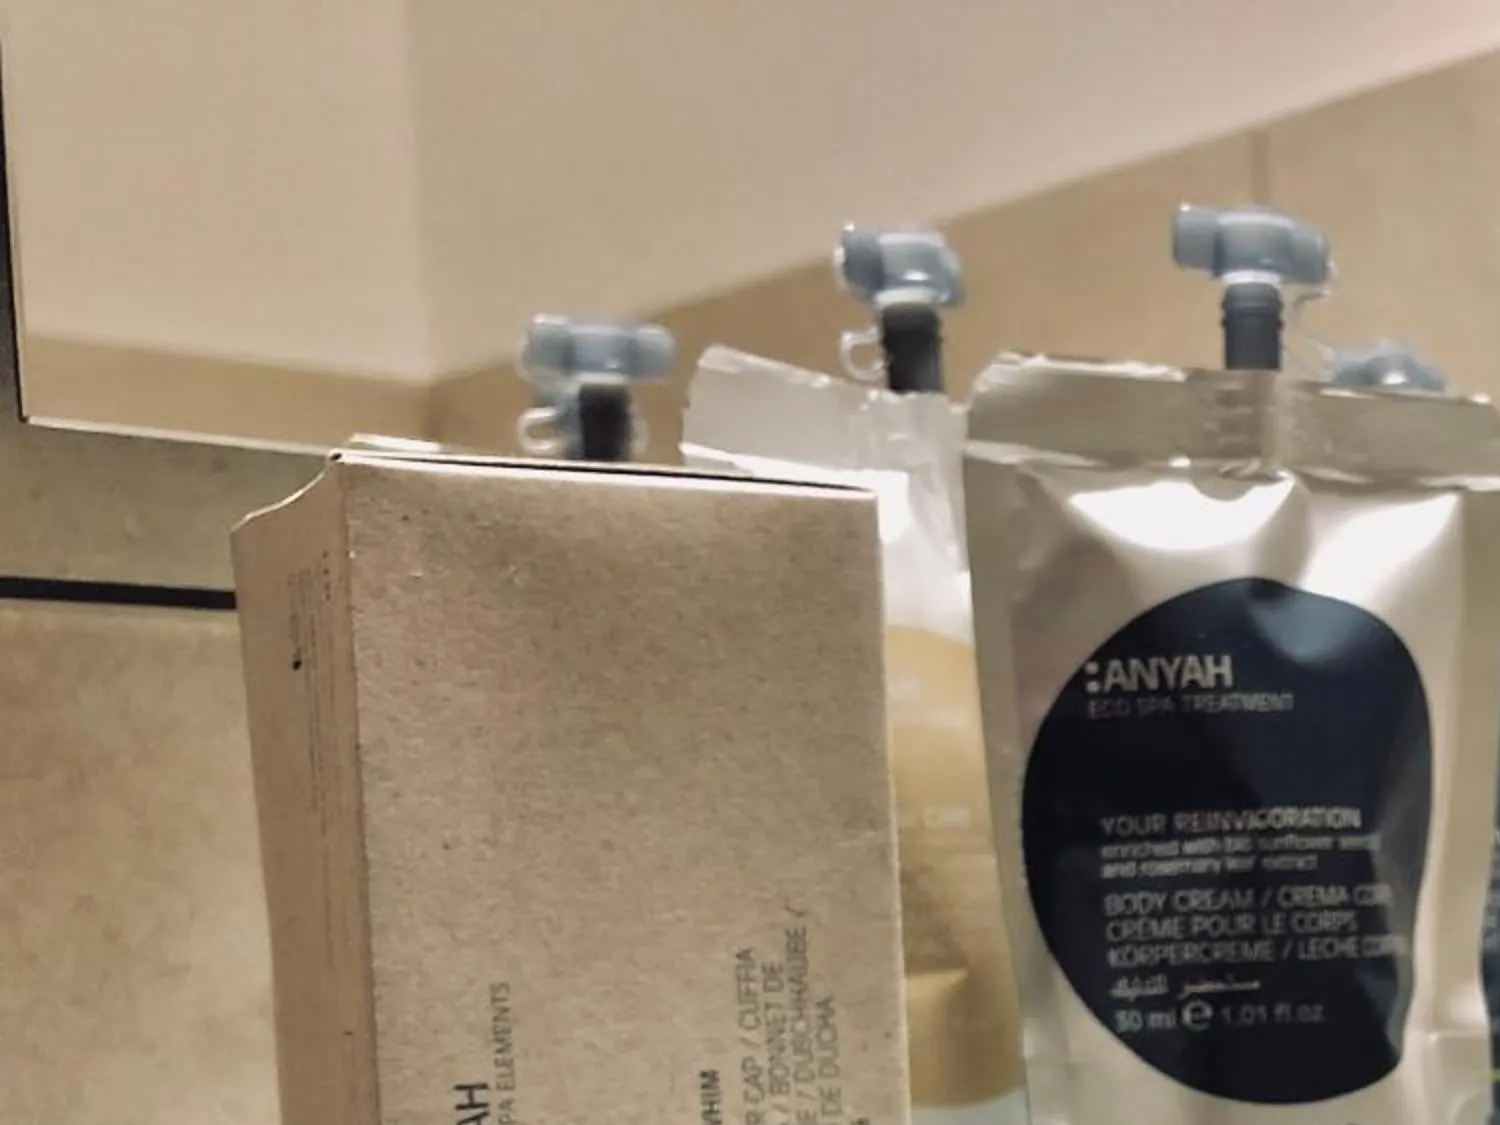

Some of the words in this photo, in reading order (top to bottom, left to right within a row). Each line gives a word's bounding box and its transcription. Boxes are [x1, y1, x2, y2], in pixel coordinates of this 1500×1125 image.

[1181, 692, 1295, 713] TREATMENT
[1101, 813, 1168, 837] YOUR
[1104, 892, 1168, 917] BODY
[1172, 888, 1255, 913] CREAM
[1191, 911, 1257, 937] POUR
[1261, 910, 1288, 935] LE
[735, 947, 762, 1032] CUFFIA
[761, 961, 785, 993] DE
[489, 981, 516, 1092] ELEMENTS
[764, 1001, 792, 1097] BONNET
[815, 996, 841, 1079] DUCHA
[741, 1055, 764, 1105] CAP
[819, 1084, 843, 1117] DE
